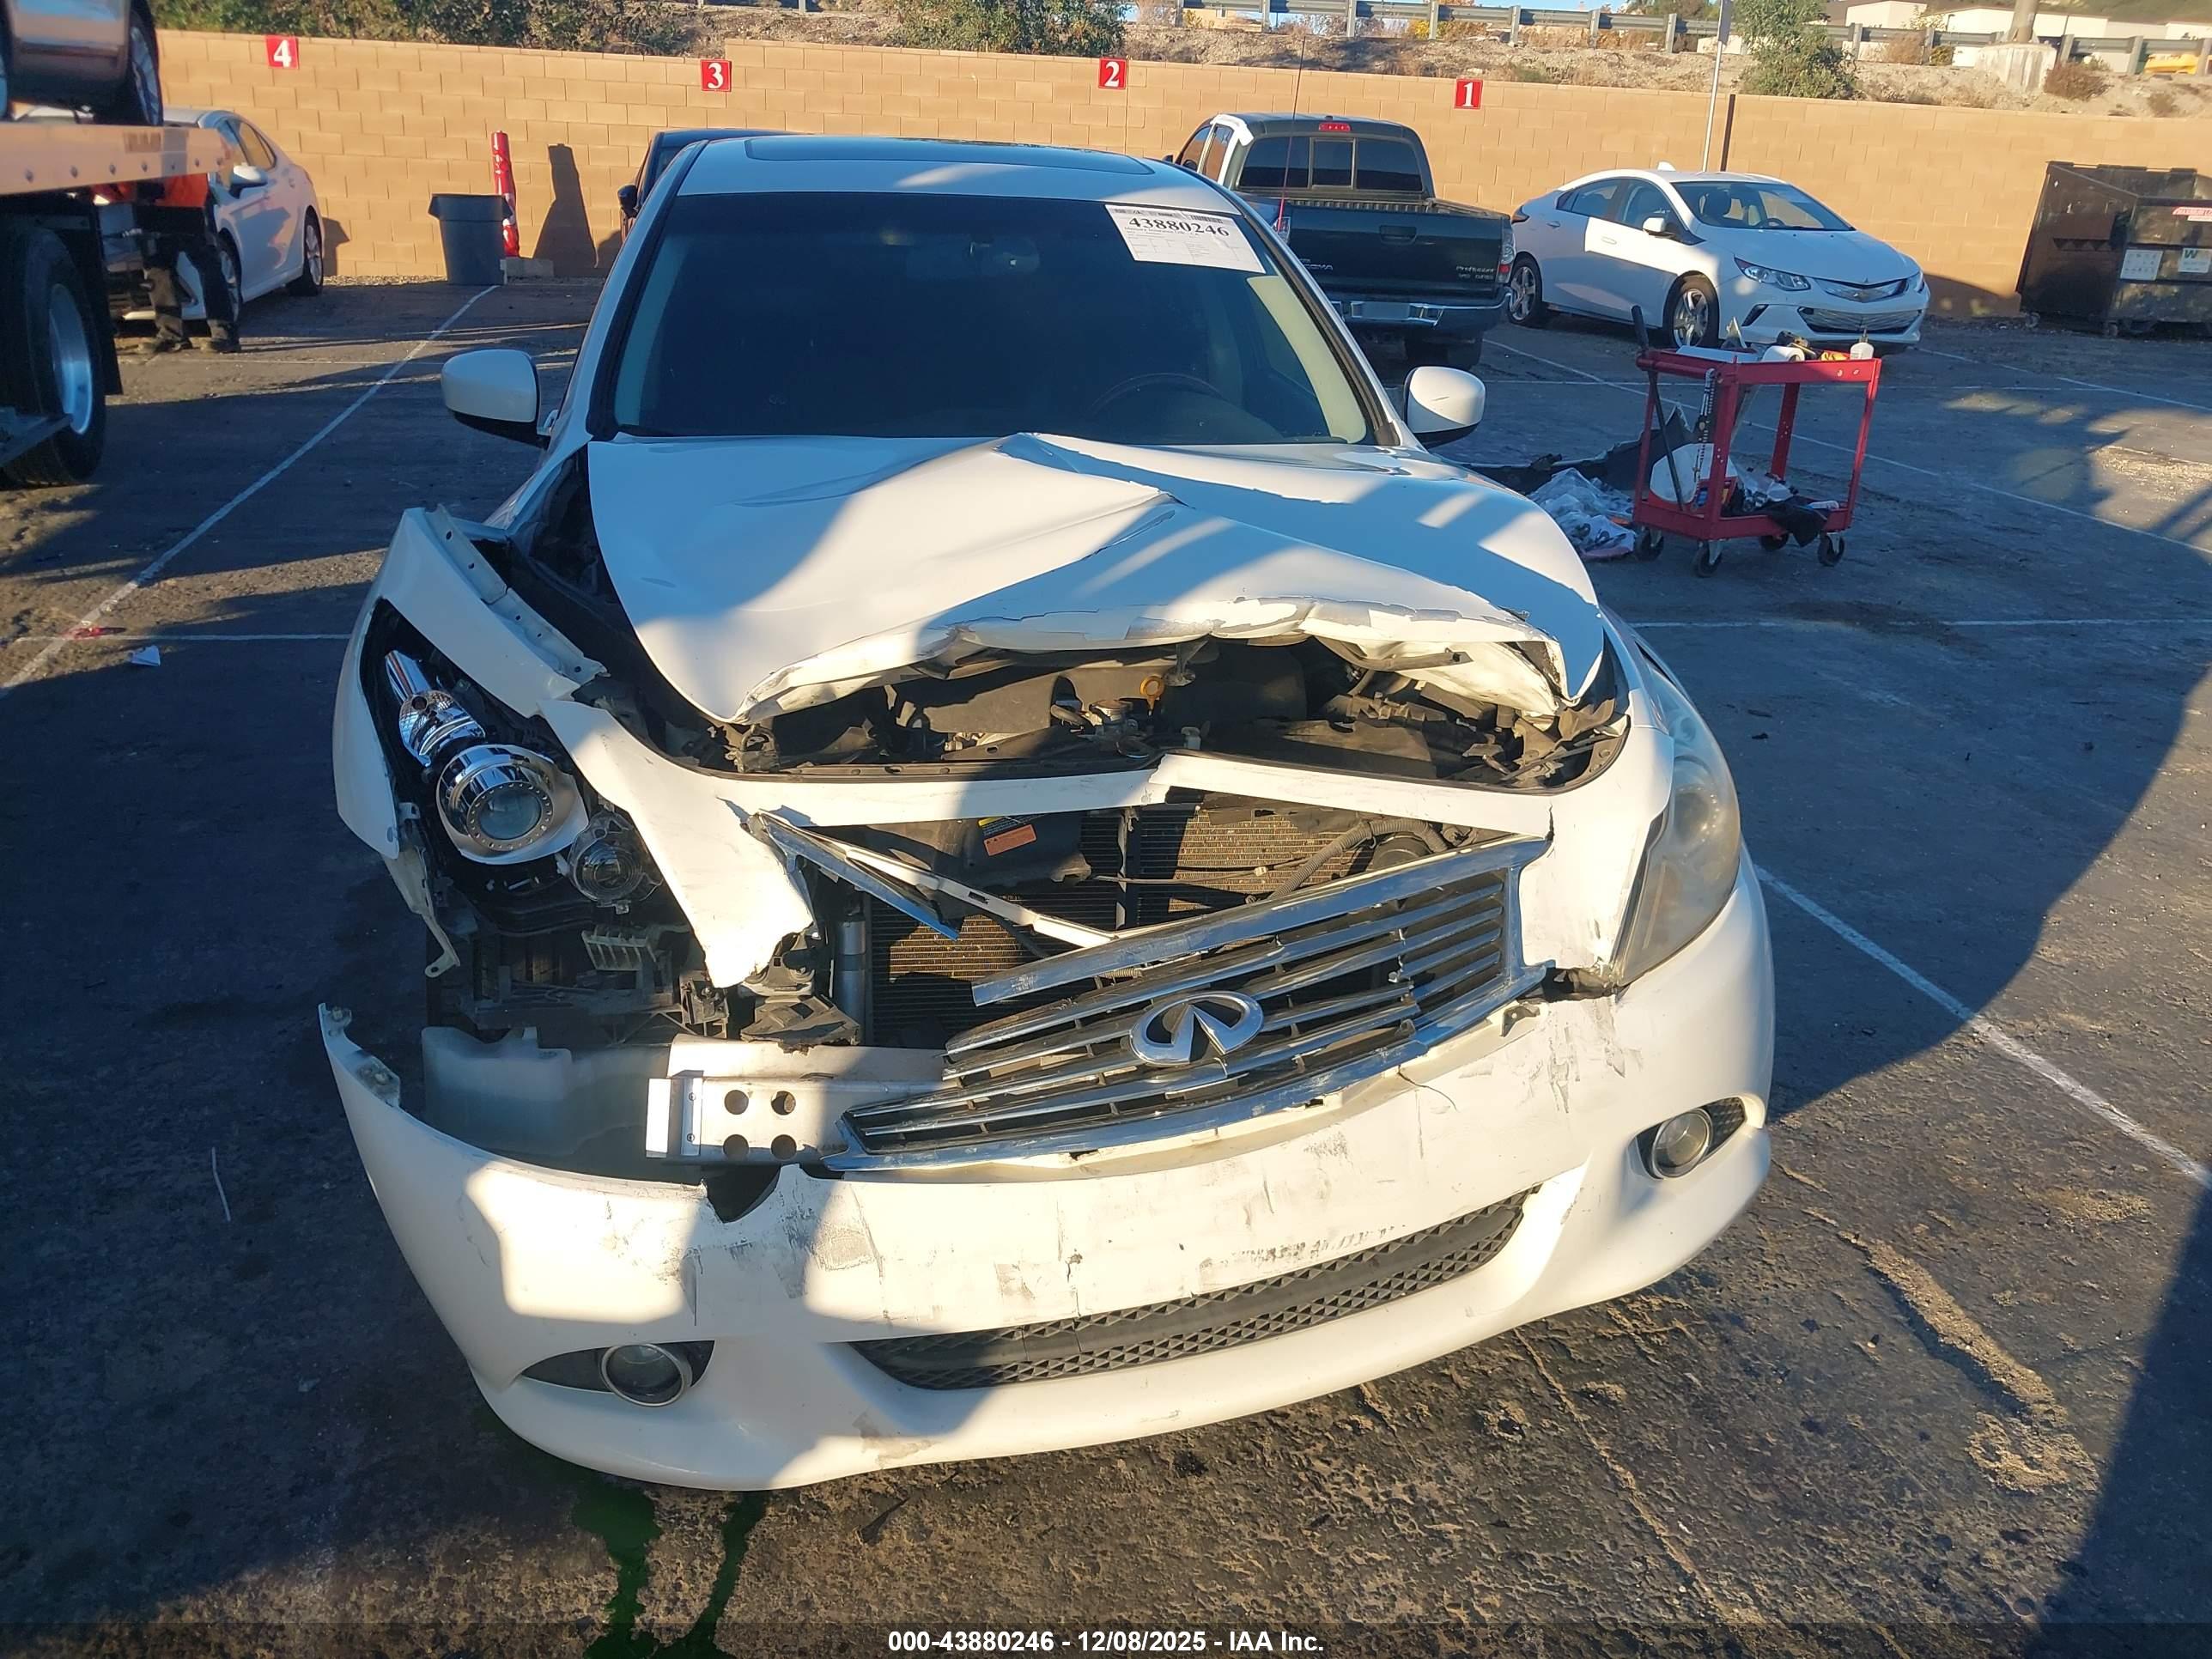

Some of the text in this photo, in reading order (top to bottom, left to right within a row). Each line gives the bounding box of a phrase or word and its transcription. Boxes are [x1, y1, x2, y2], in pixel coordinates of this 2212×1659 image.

[274, 40, 292, 67] 4
[707, 62, 724, 89] 3
[1104, 61, 1120, 88] 2
[1462, 82, 1474, 107] 1
[1129, 217, 1230, 237] 43880246
